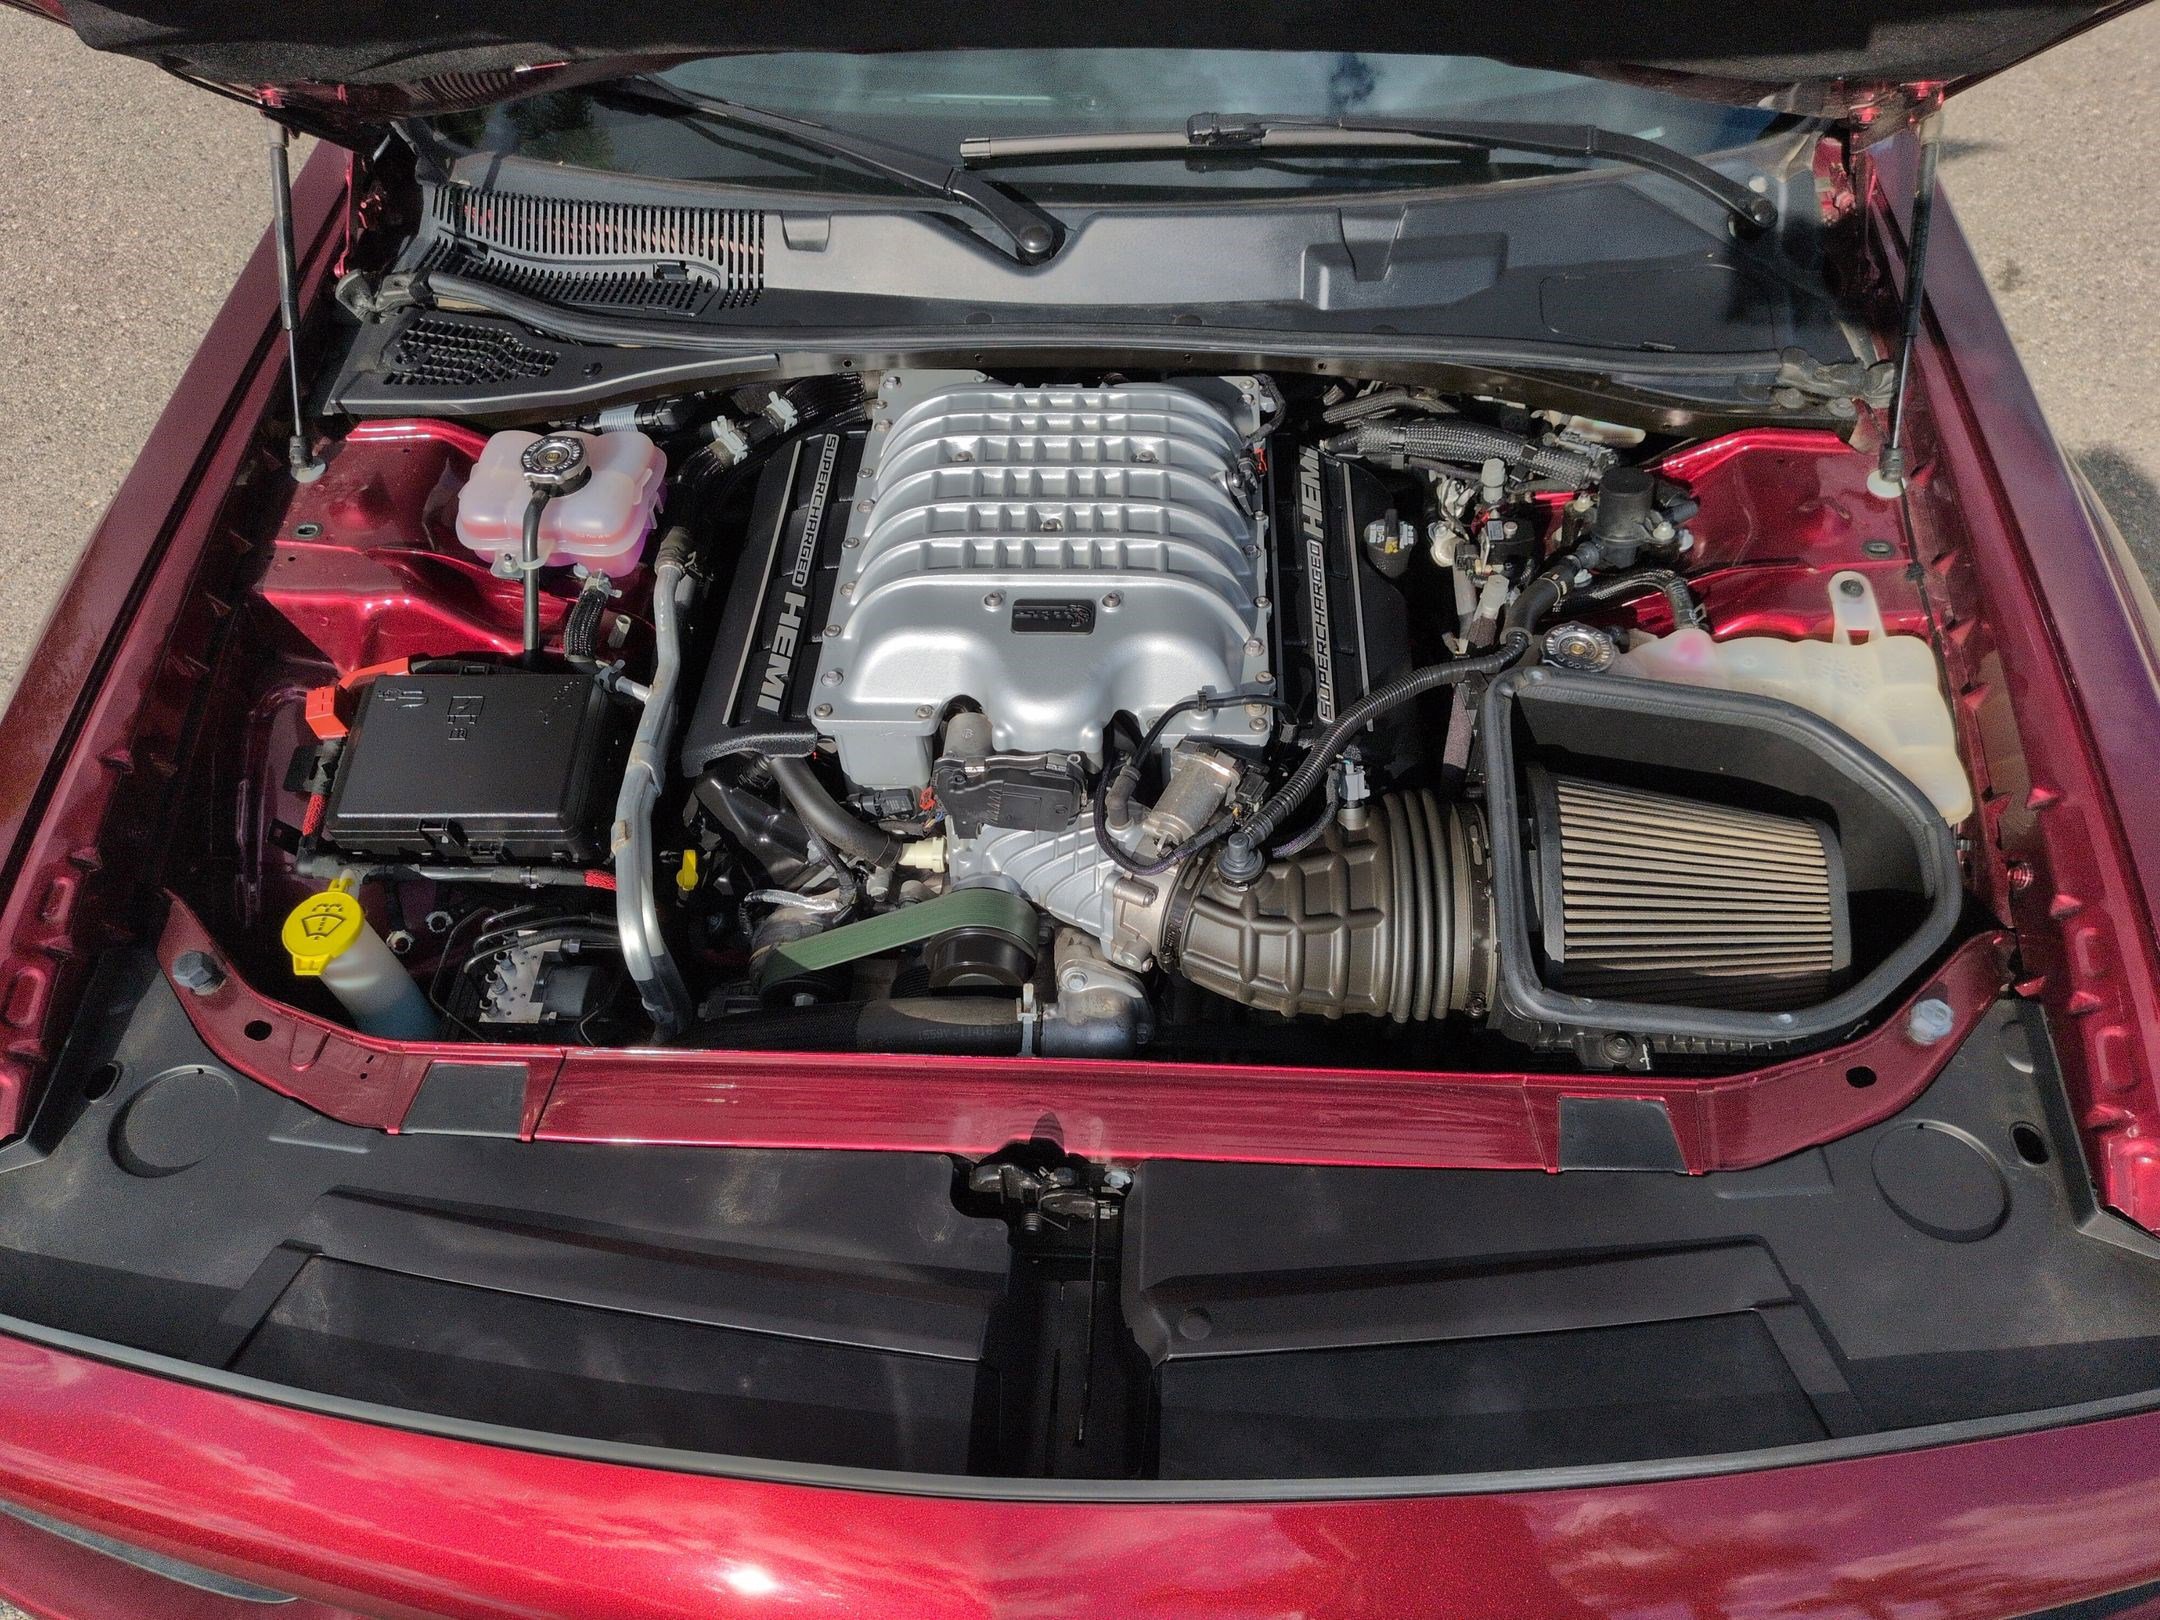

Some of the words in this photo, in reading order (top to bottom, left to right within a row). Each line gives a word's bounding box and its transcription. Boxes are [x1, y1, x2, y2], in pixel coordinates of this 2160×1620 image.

[794, 435, 837, 586] SUPERCHARGED
[1300, 447, 1323, 539] HEMI
[758, 592, 806, 713] HEMI
[1309, 541, 1334, 722] SUPERCHARGED
